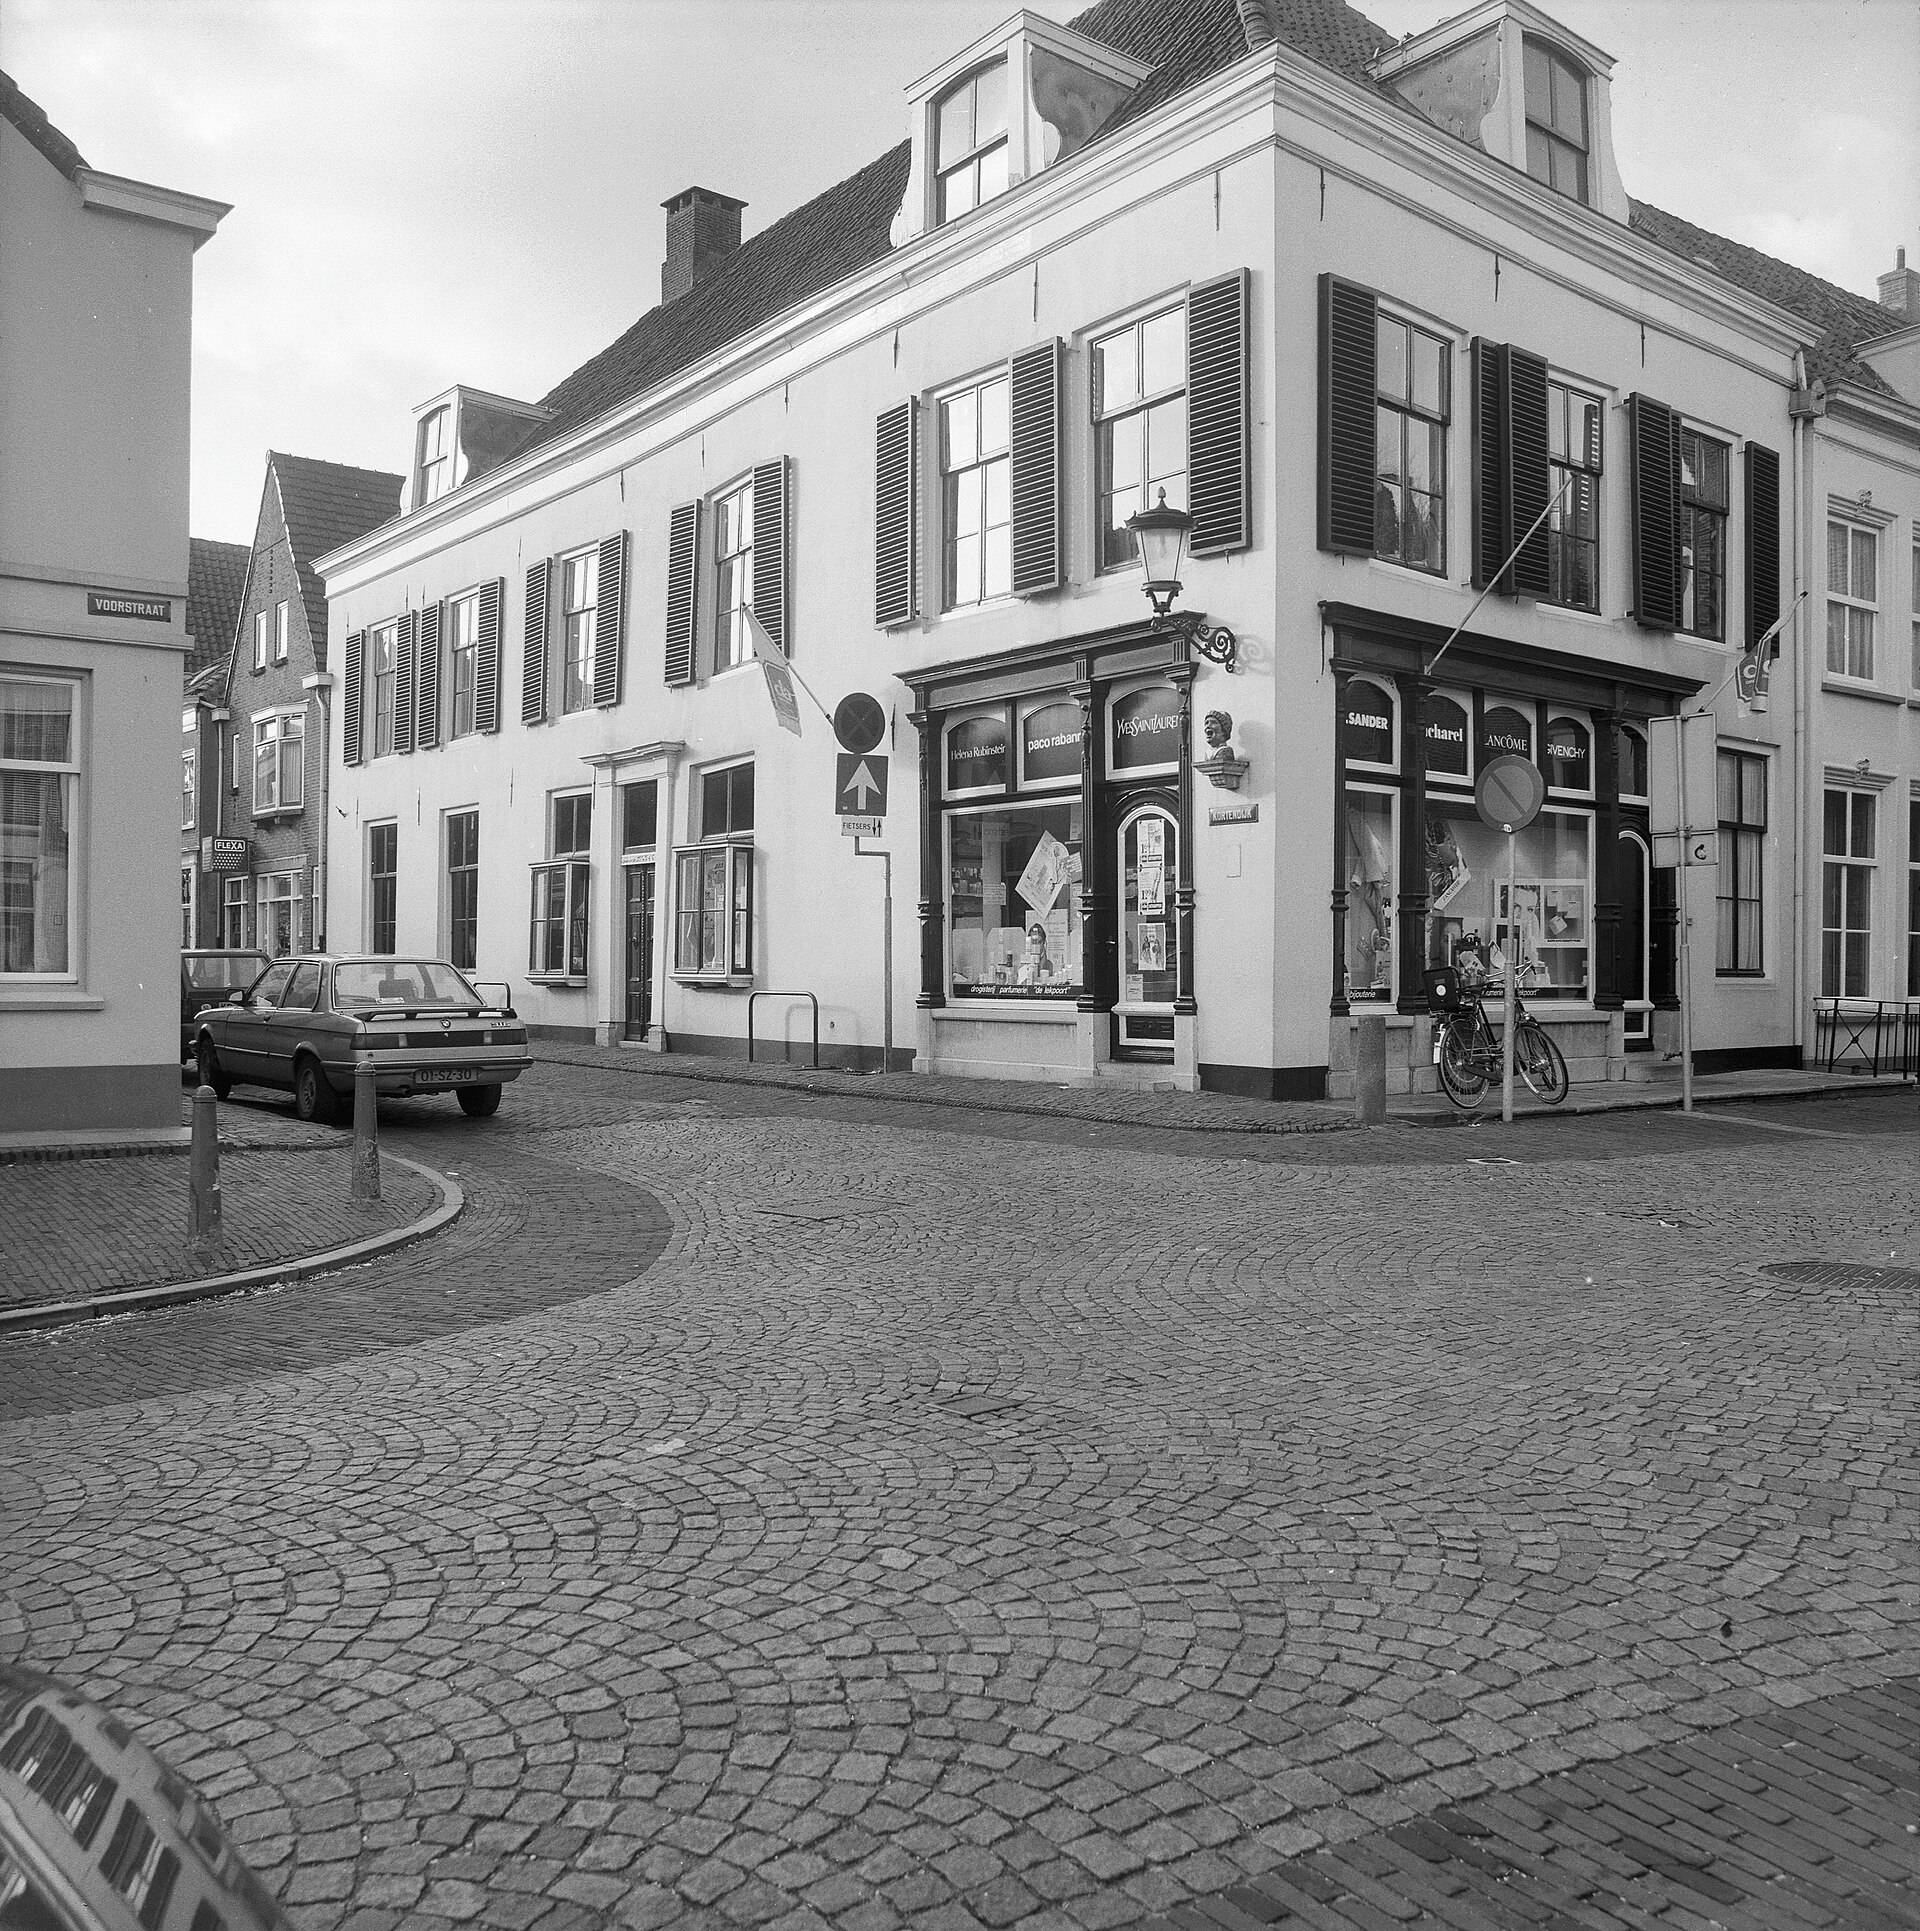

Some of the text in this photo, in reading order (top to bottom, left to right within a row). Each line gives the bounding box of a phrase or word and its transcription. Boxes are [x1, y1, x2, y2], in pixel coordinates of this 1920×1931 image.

[95, 598, 165, 616] VOORSTRAAT
[1346, 712, 1388, 730] SANDER
[1028, 738, 1051, 753] paco
[951, 749, 973, 761] Helena
[842, 822, 871, 830] FIETSERS
[217, 841, 243, 850] FLEXA
[970, 985, 996, 994] drogisterij
[999, 986, 1028, 994] parfumerie
[1350, 990, 1376, 999] bijouterie
[421, 1069, 472, 1082] 01-SZ-30
